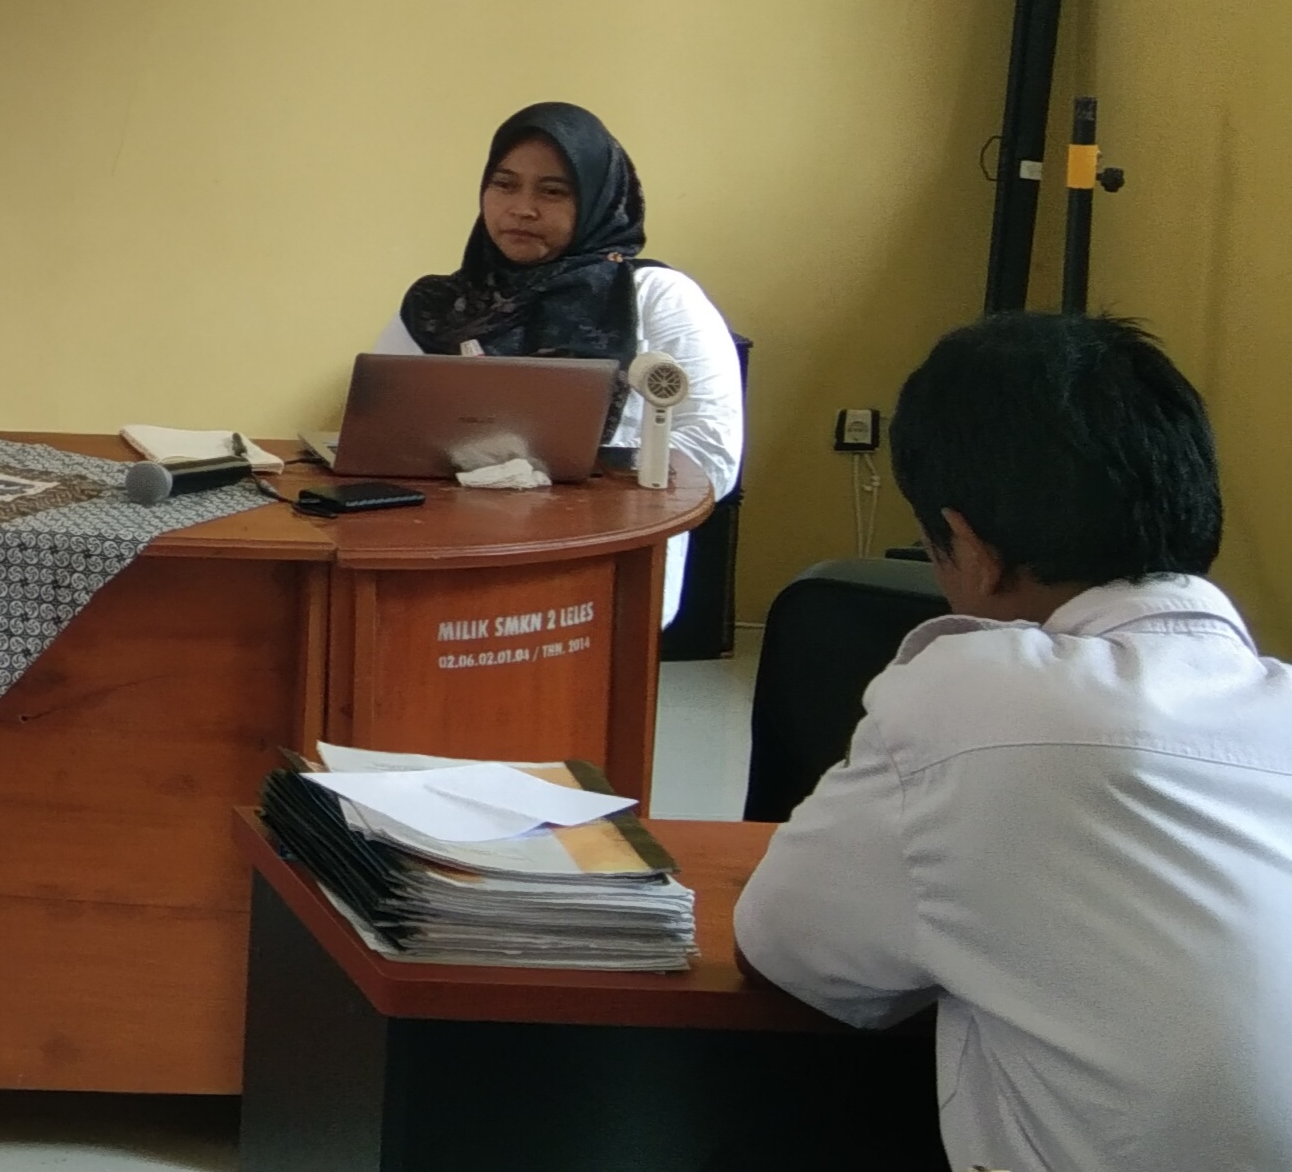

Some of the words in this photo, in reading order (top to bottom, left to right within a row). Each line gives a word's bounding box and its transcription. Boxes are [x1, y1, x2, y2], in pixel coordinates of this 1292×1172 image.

[437, 619, 489, 641] MILIK
[495, 612, 542, 637] SMKN
[547, 609, 556, 629] 2
[560, 601, 594, 627] LELES
[568, 636, 590, 653] 2014
